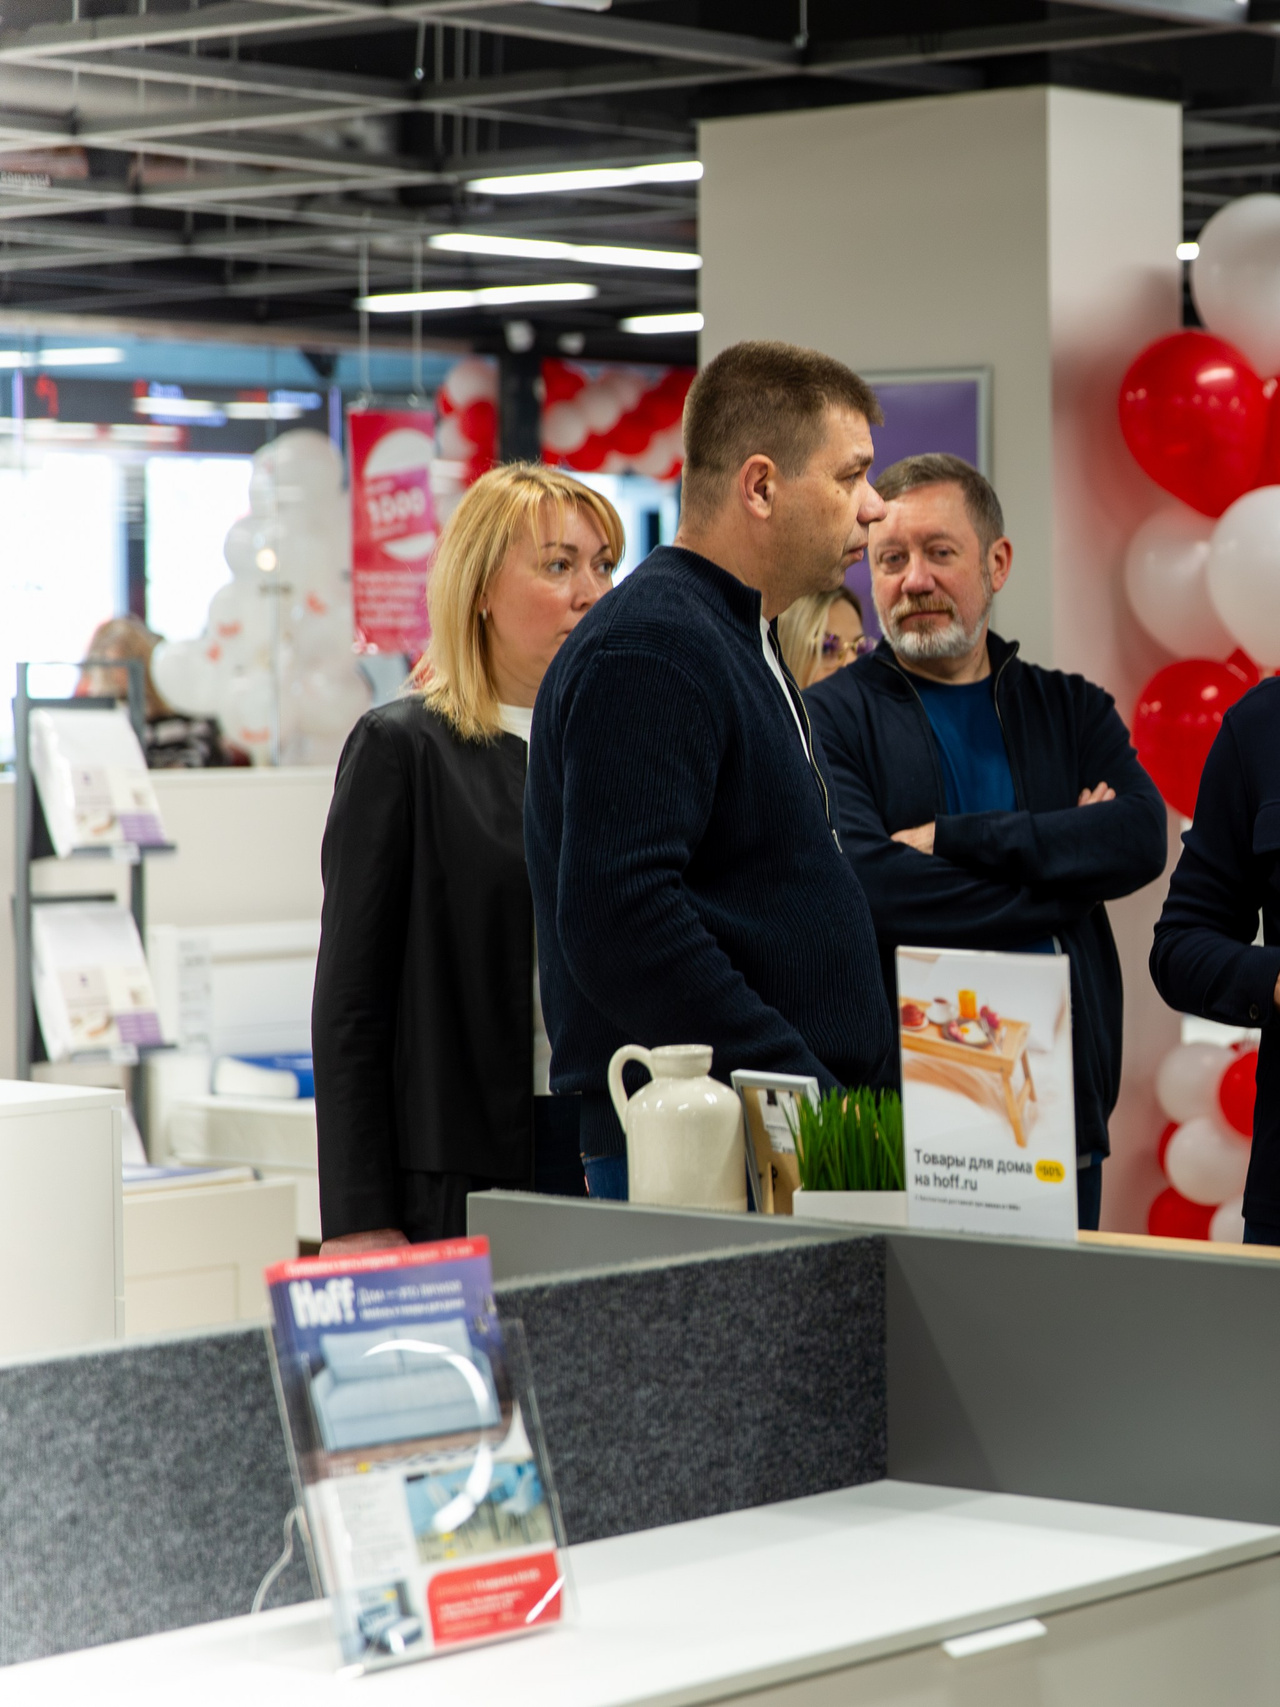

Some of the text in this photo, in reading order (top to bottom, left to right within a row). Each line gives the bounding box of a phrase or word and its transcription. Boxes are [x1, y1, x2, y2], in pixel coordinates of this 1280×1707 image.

[914, 1149, 1032, 1175] Товары для дома
[914, 1173, 978, 1191] на hoff.ru
